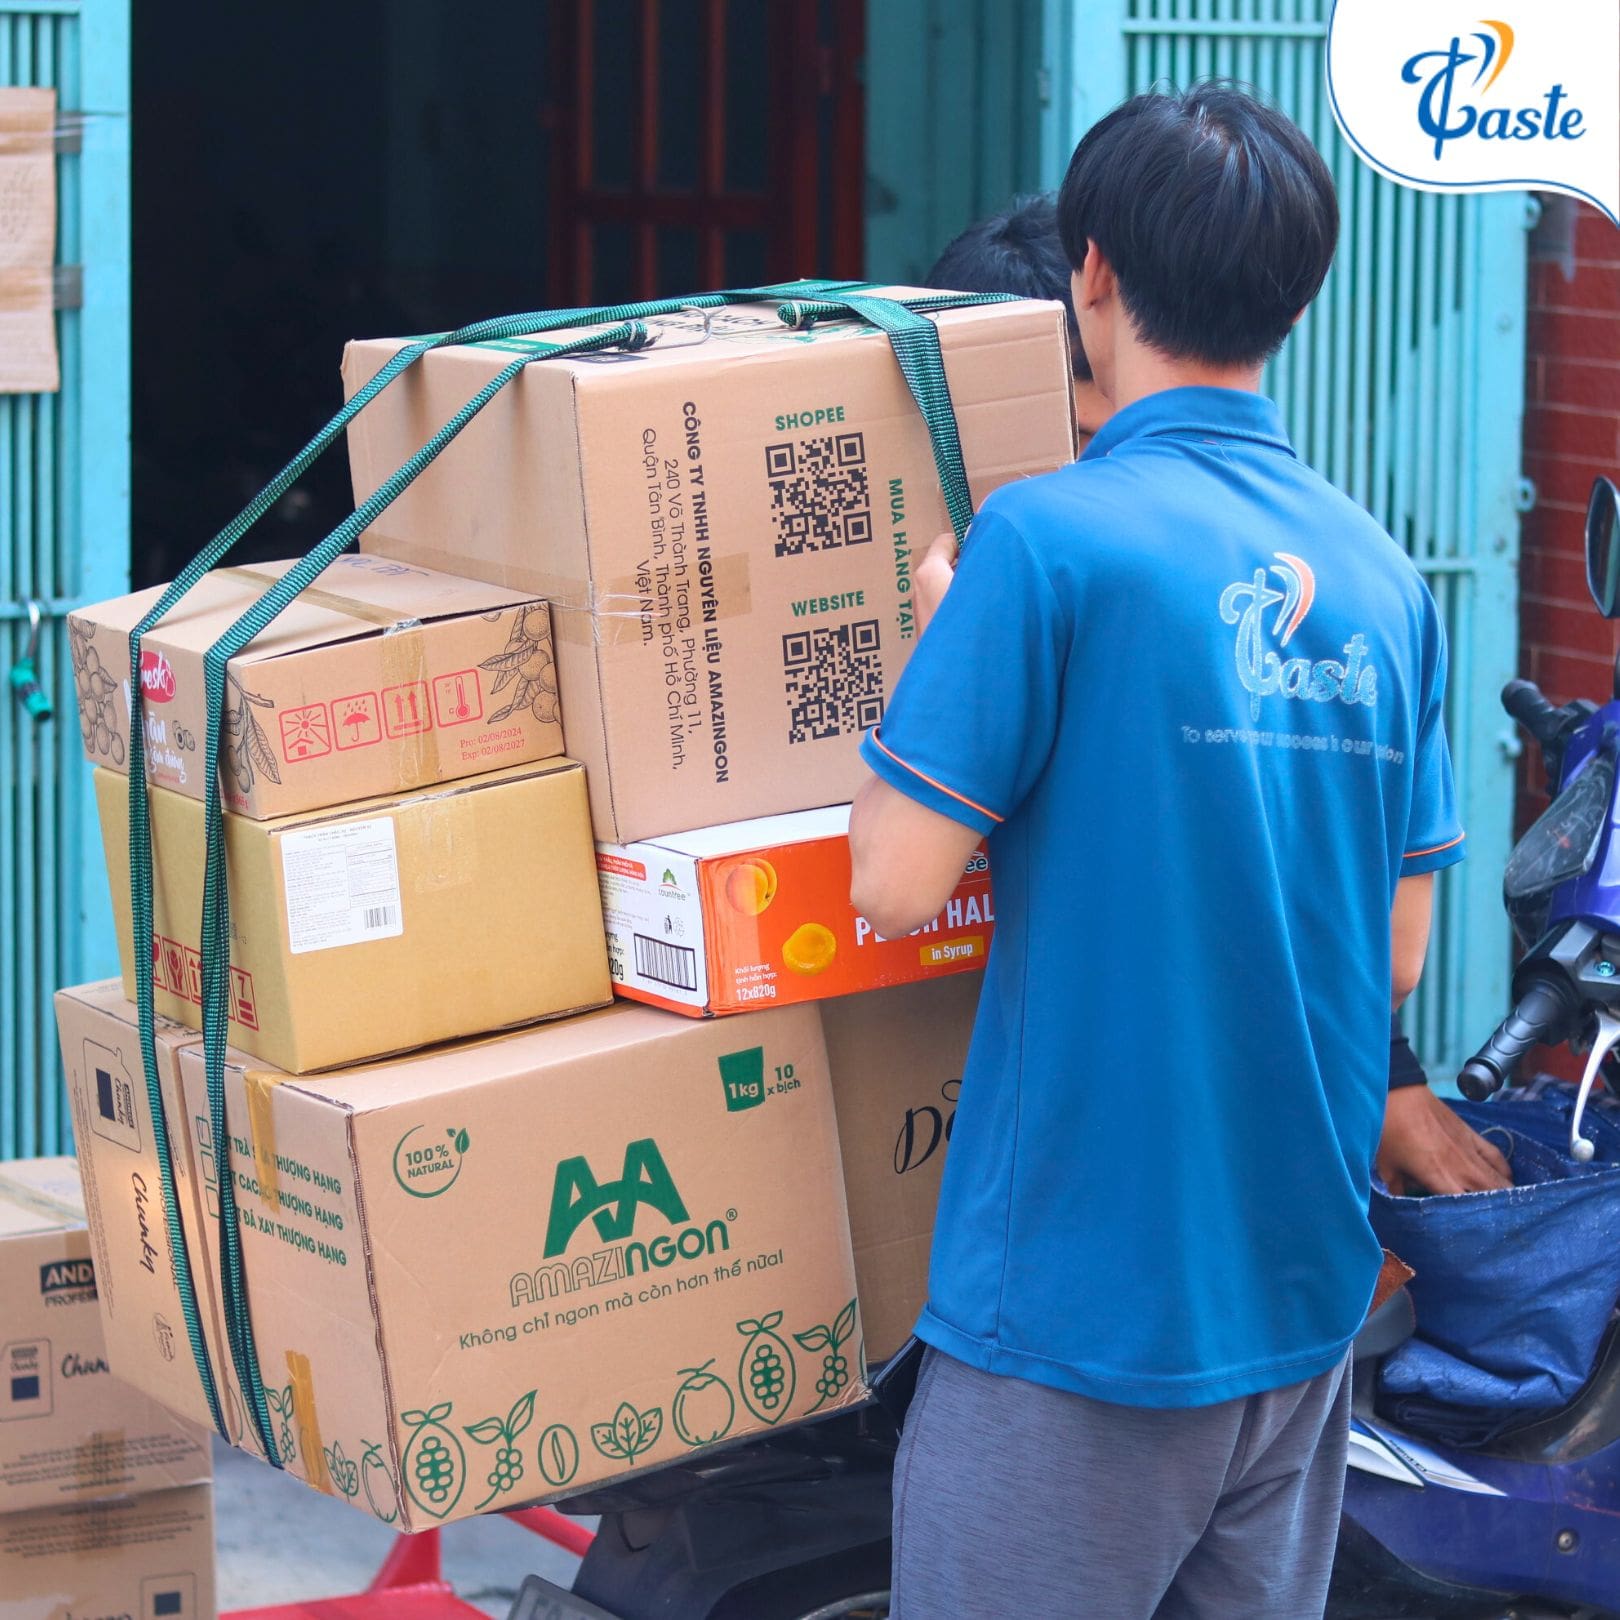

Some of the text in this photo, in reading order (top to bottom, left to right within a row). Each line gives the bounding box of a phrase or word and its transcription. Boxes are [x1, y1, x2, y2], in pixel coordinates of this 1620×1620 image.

[775, 406, 845, 431] SHOPEE
[889, 478, 914, 640] MUA HÀNG TẠI:
[635, 560, 654, 646] Việt Nam.
[642, 428, 686, 770] Quận Tân Bình, Thành phố Hồ Chí Minh,
[664, 458, 702, 734] 240 Võ Thành Trang, Phường 11,
[683, 401, 729, 784] CÔNG TY TNHH NGUYÊN LIỆU AMAZINGON
[791, 590, 865, 617] WEBSITE
[946, 894, 995, 928] HAL
[932, 943, 973, 961] in Syrup
[736, 984, 776, 1001] 12x820g
[774, 1063, 794, 1082] 10
[728, 1082, 759, 1099] 1kg
[776, 1078, 801, 1094] bịch
[233, 1137, 250, 1158] TRÀ
[313, 1170, 342, 1195] HẠNG
[405, 1144, 449, 1166] 100%
[407, 1159, 455, 1179] NATURAL
[131, 1172, 158, 1274] Chunky
[315, 1205, 344, 1231] HẠNG
[258, 1216, 275, 1237] XAY
[277, 1223, 316, 1254] THƯỢNG
[317, 1240, 347, 1267] HẠNG
[45, 1264, 93, 1287] AND
[459, 1325, 517, 1350] Không
[523, 1311, 550, 1335] chỉ
[555, 1304, 600, 1328] ngon
[605, 1292, 633, 1313] mà
[638, 1284, 672, 1304] còn
[676, 1273, 709, 1294] hơn
[713, 1258, 743, 1284] thế
[61, 1353, 110, 1378] Chun
